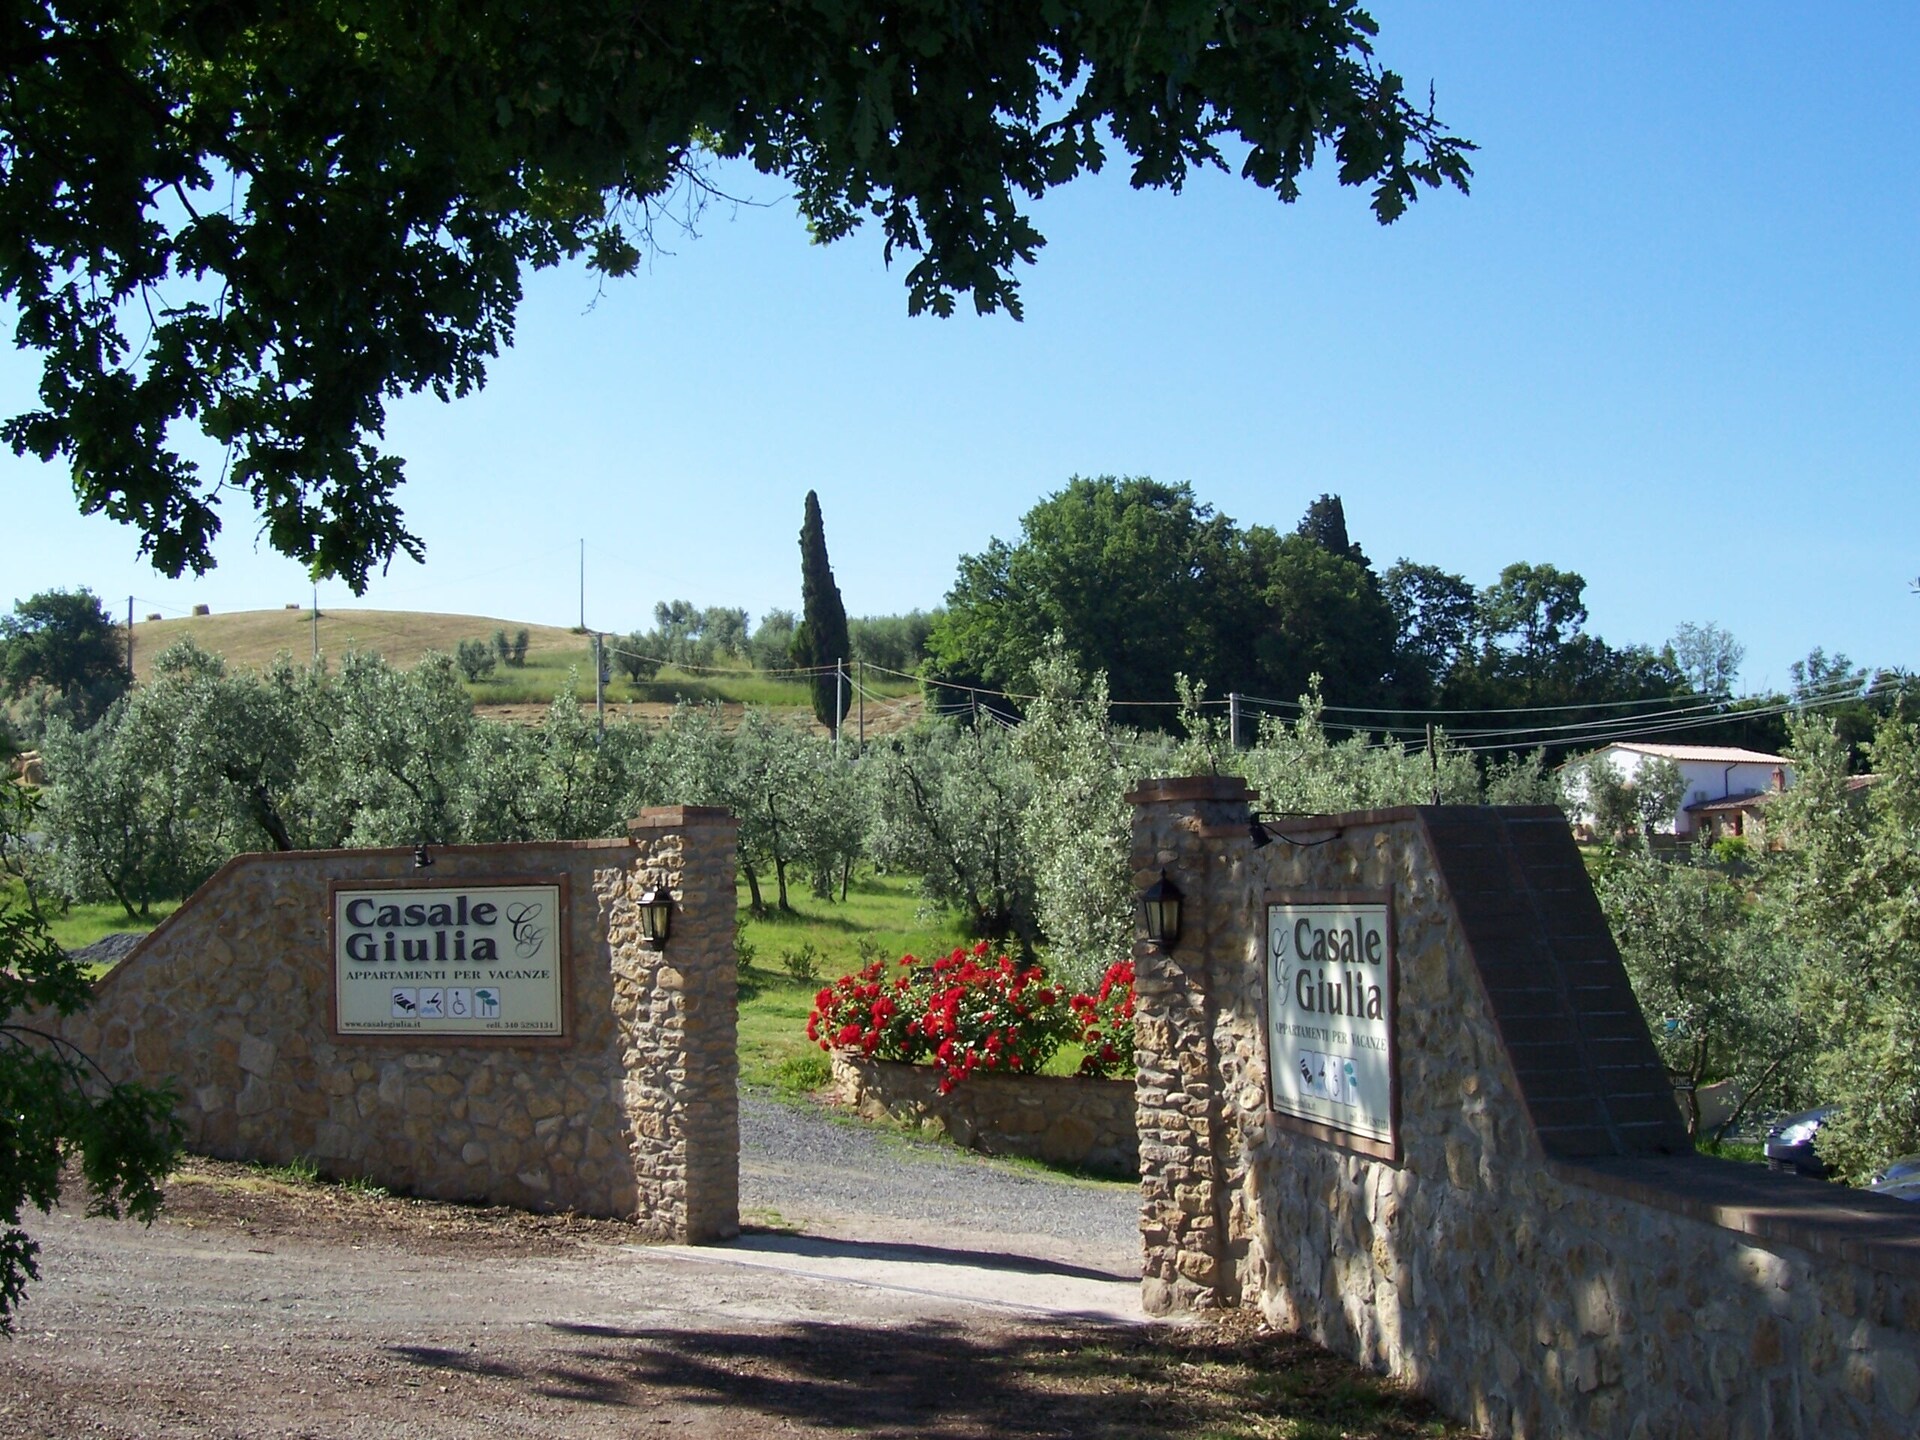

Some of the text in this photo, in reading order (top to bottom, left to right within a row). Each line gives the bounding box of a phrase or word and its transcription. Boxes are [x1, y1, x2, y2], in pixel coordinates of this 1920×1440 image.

[345, 895, 498, 928] Casale
[345, 930, 499, 962] Giulia
[1294, 917, 1382, 966] Casale
[346, 970, 550, 980] APPARTAMENTI PER VACANZE
[1295, 968, 1384, 1021] Giulia
[344, 1020, 421, 1028] www.casalegiulia.it
[1275, 1022, 1387, 1052] APPARTAMENTI PER VACANZE
